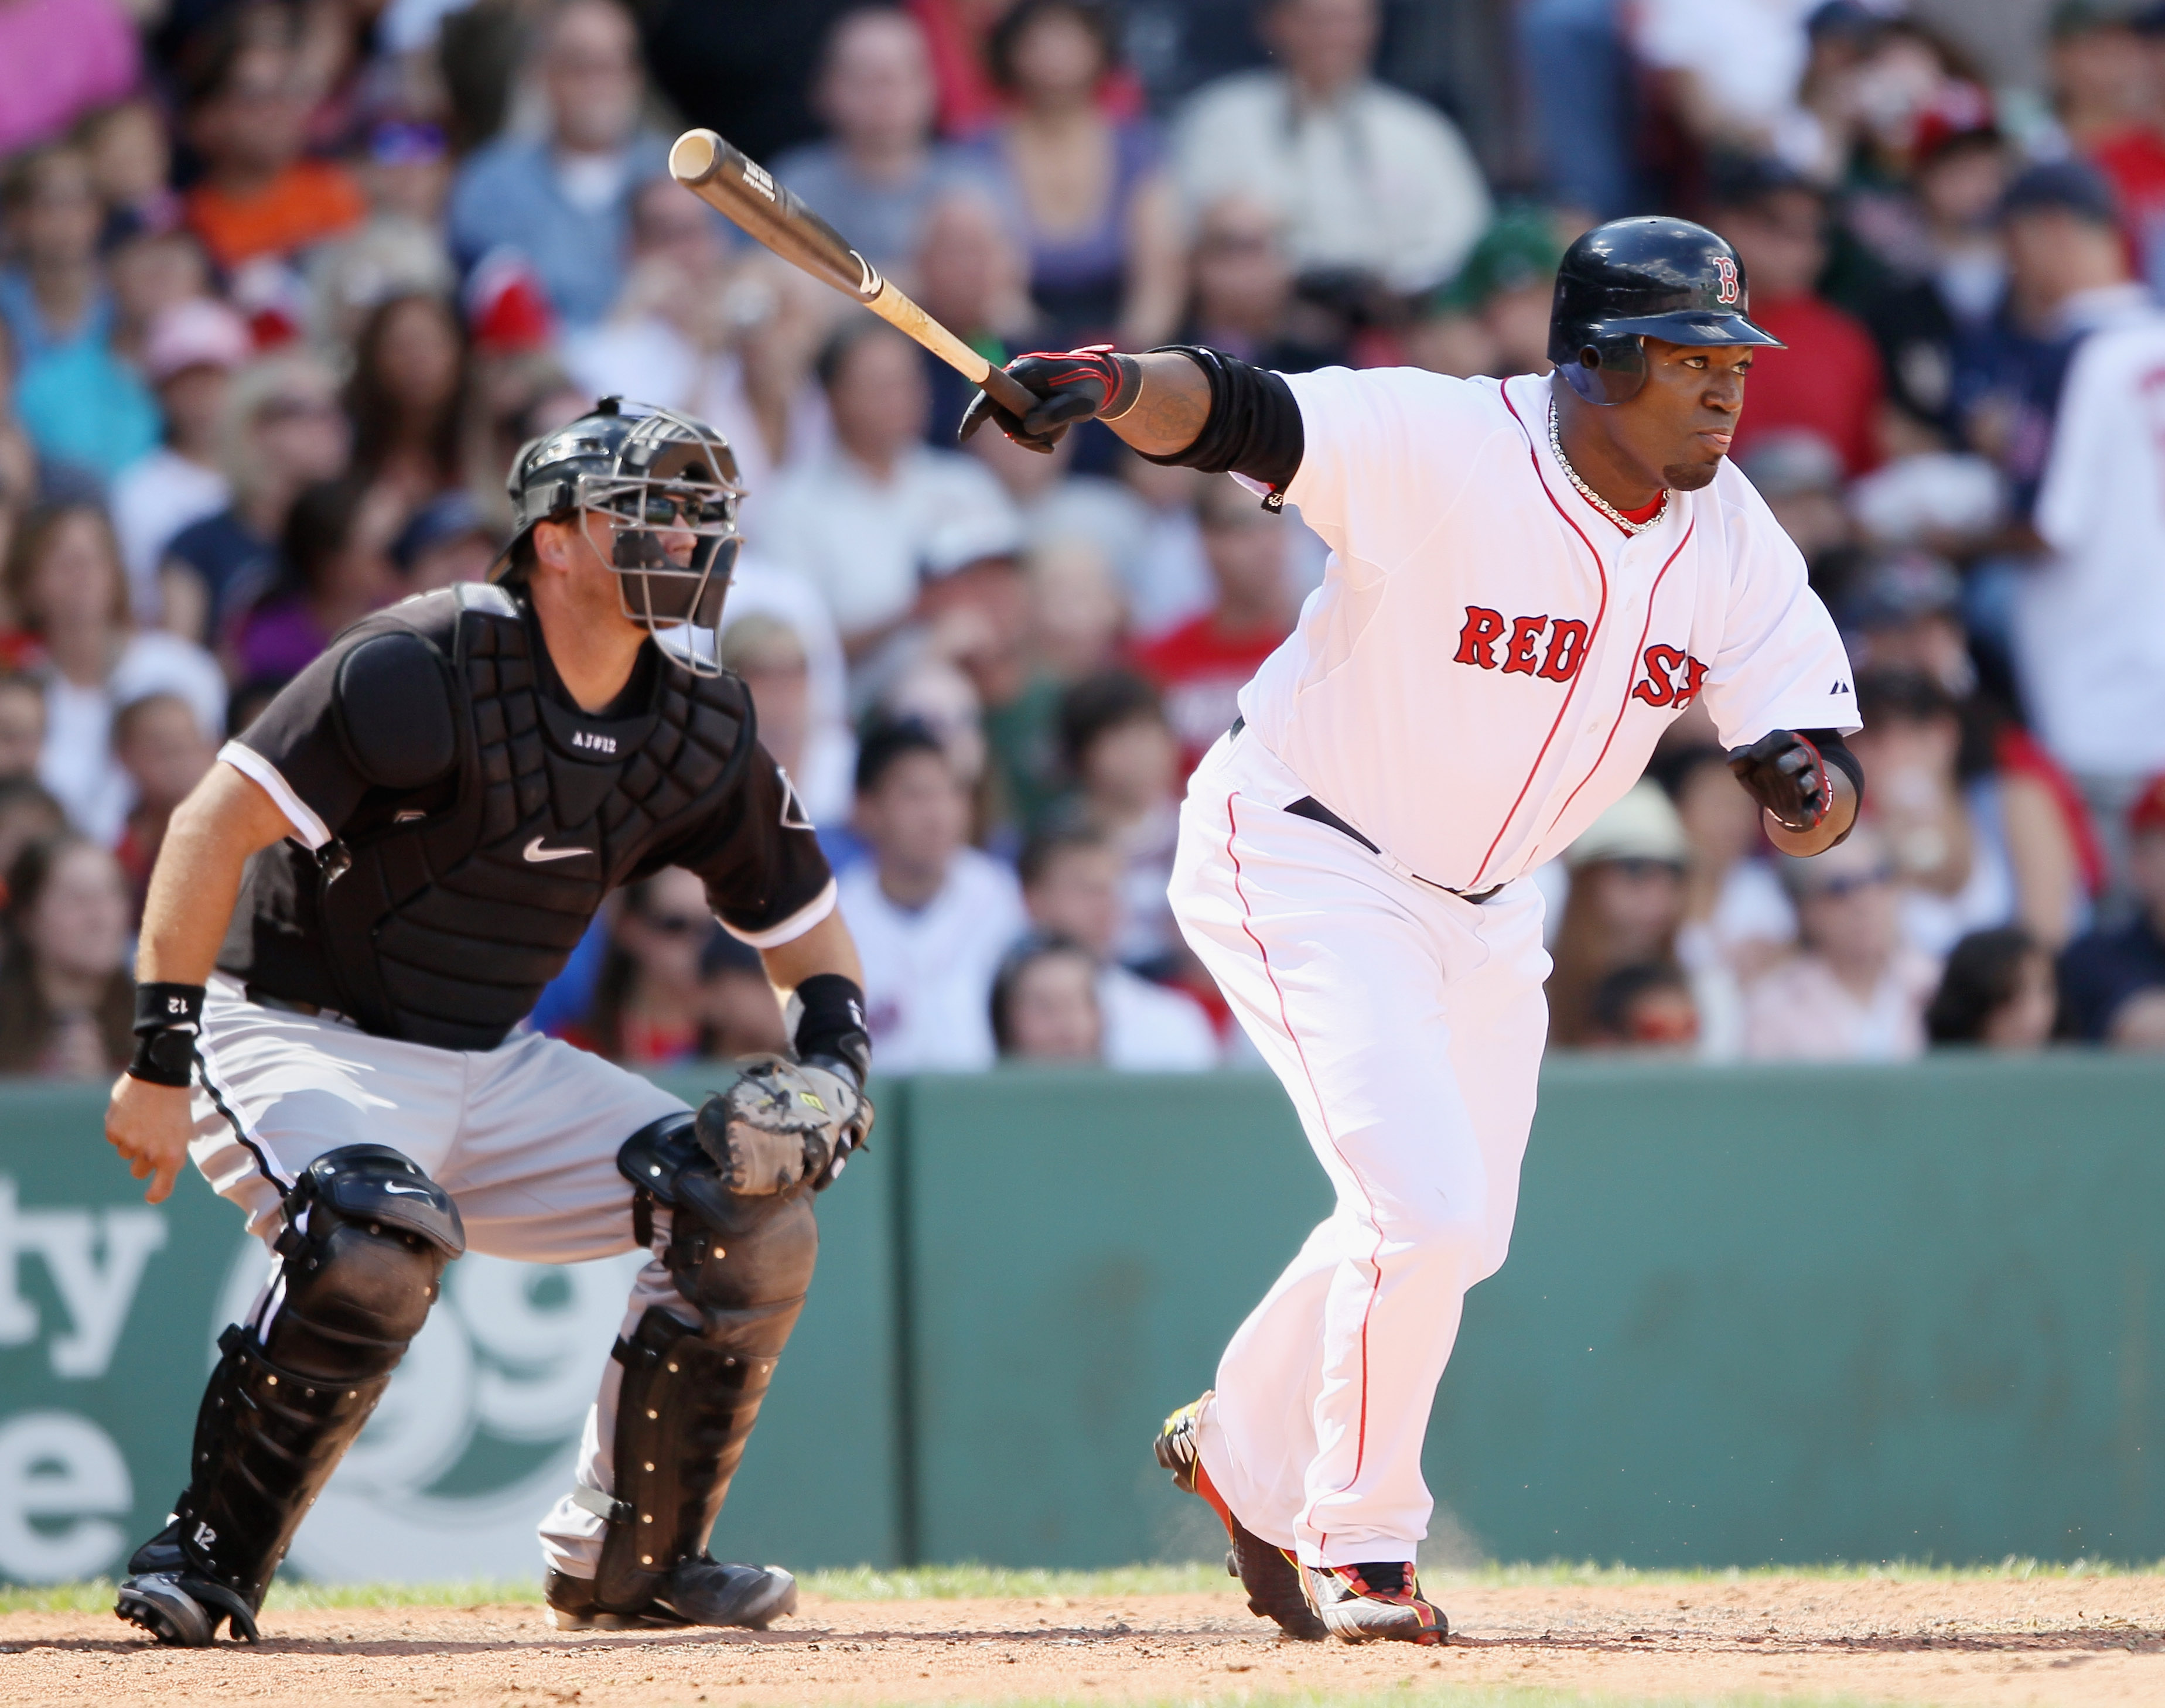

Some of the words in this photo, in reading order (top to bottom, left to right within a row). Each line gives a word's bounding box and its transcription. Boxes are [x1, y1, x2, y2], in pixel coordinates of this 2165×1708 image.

[1712, 257, 1740, 304] B
[1453, 606, 1588, 683] RED
[168, 998, 188, 1014] 12
[194, 1522, 217, 1551] 12
